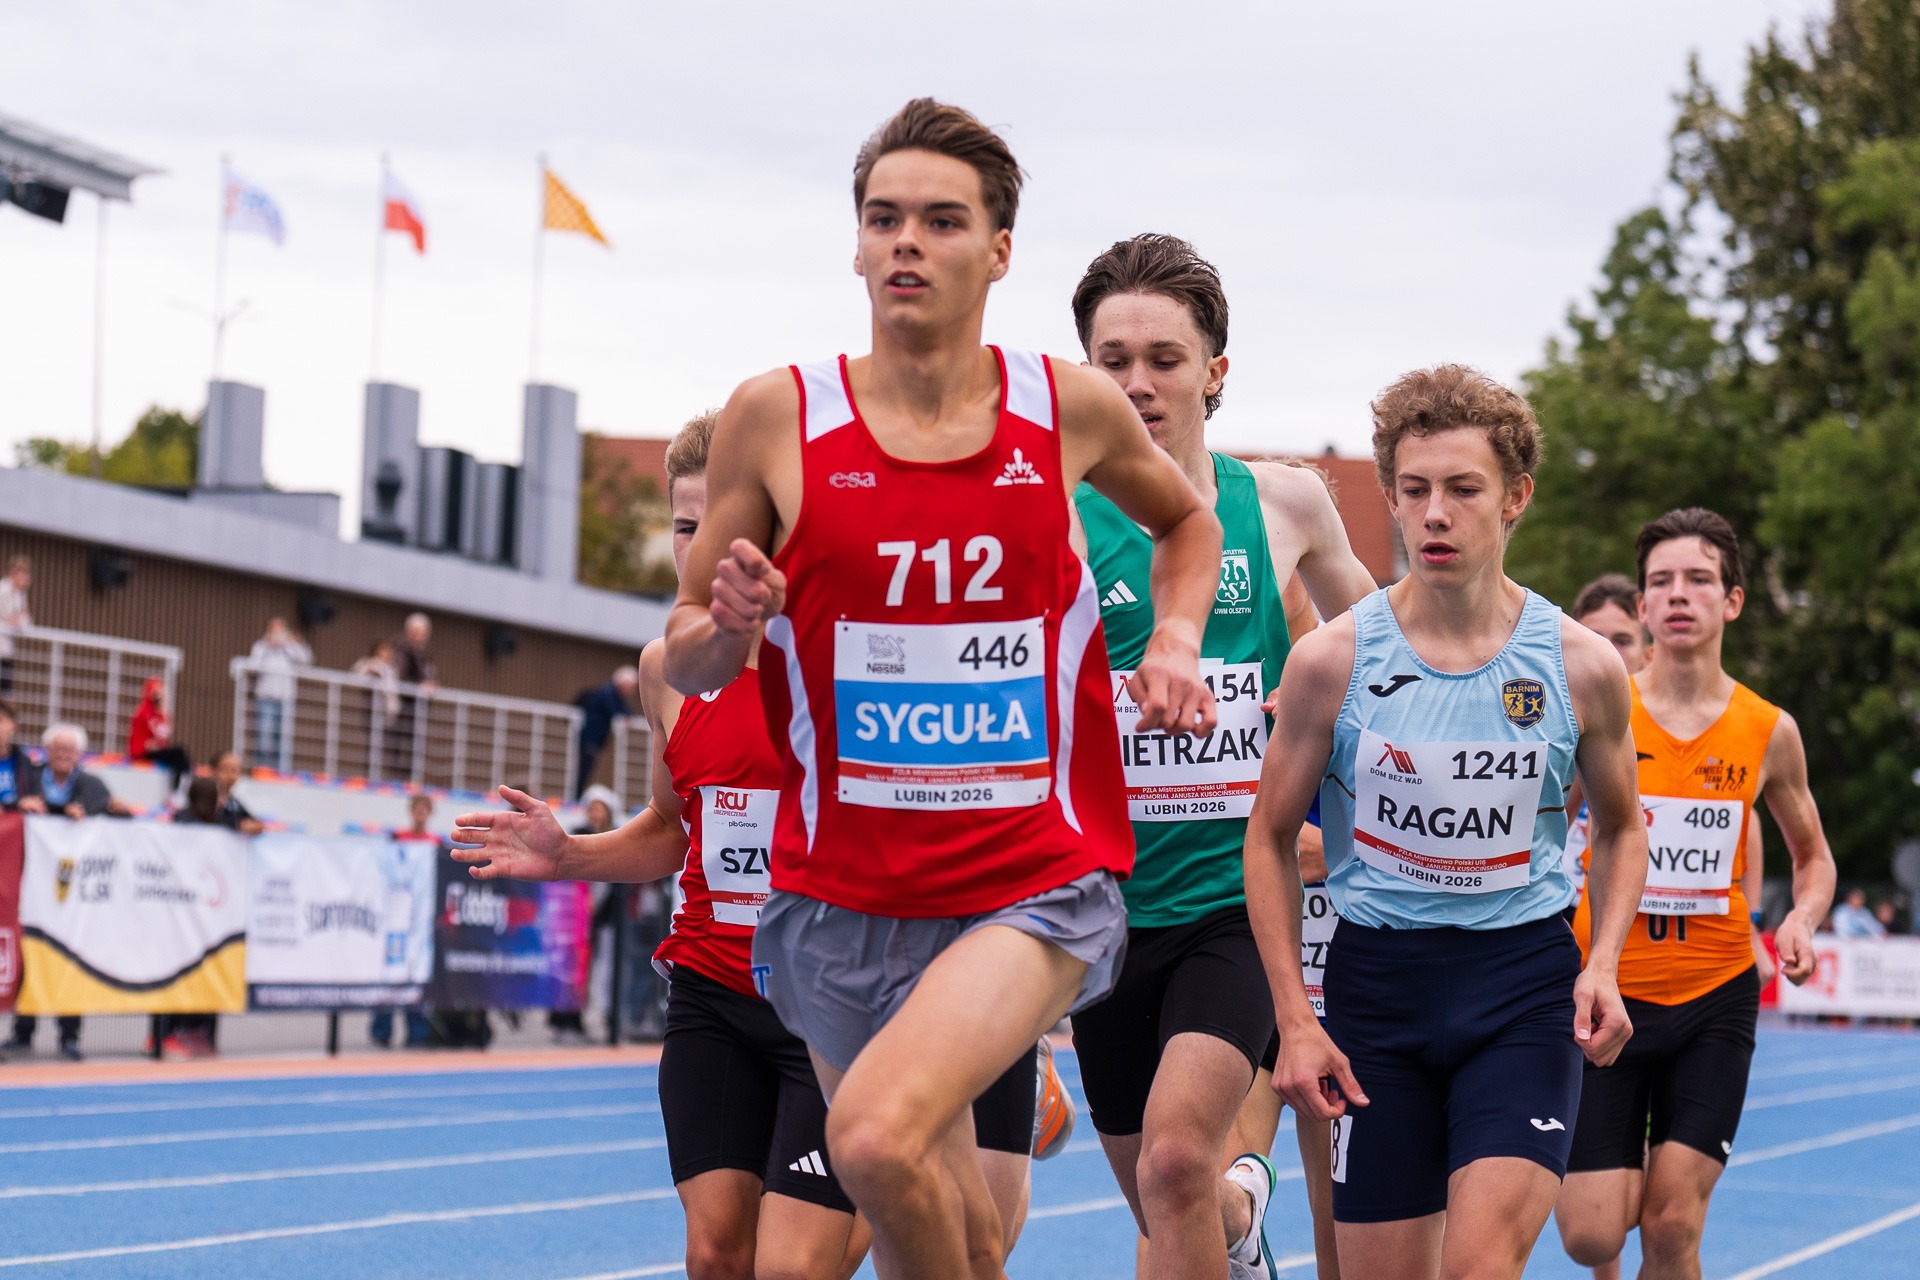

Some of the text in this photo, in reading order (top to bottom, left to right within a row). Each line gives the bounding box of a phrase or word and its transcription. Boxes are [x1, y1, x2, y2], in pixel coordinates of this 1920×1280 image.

[829, 471, 877, 488] esa
[877, 535, 1004, 606] 712
[958, 633, 1029, 670] 446
[1506, 685, 1540, 693] BARNIM
[855, 699, 1032, 745] SYGUŁA
[1370, 767, 1423, 785] DOM BEZ WAD
[1452, 750, 1540, 781] 1241
[894, 788, 993, 803] LUBIN 2026
[1200, 788, 1250, 798] KUSOCIŃSKIEGO
[1144, 801, 1227, 815] LUBIN 2026
[1377, 793, 1515, 839] RAGAN
[1684, 807, 1730, 829] 408
[1393, 851, 1424, 867] MEMORIAŁ
[1425, 863, 1456, 872] JANUSZA
[1457, 862, 1507, 872] KUSOCIŃSKIEGO
[1398, 848, 1416, 859] PZLA
[1414, 853, 1453, 866] Mistrzostwa
[1649, 846, 1721, 874] NYCH
[1398, 863, 1482, 887] LUBIN 2026
